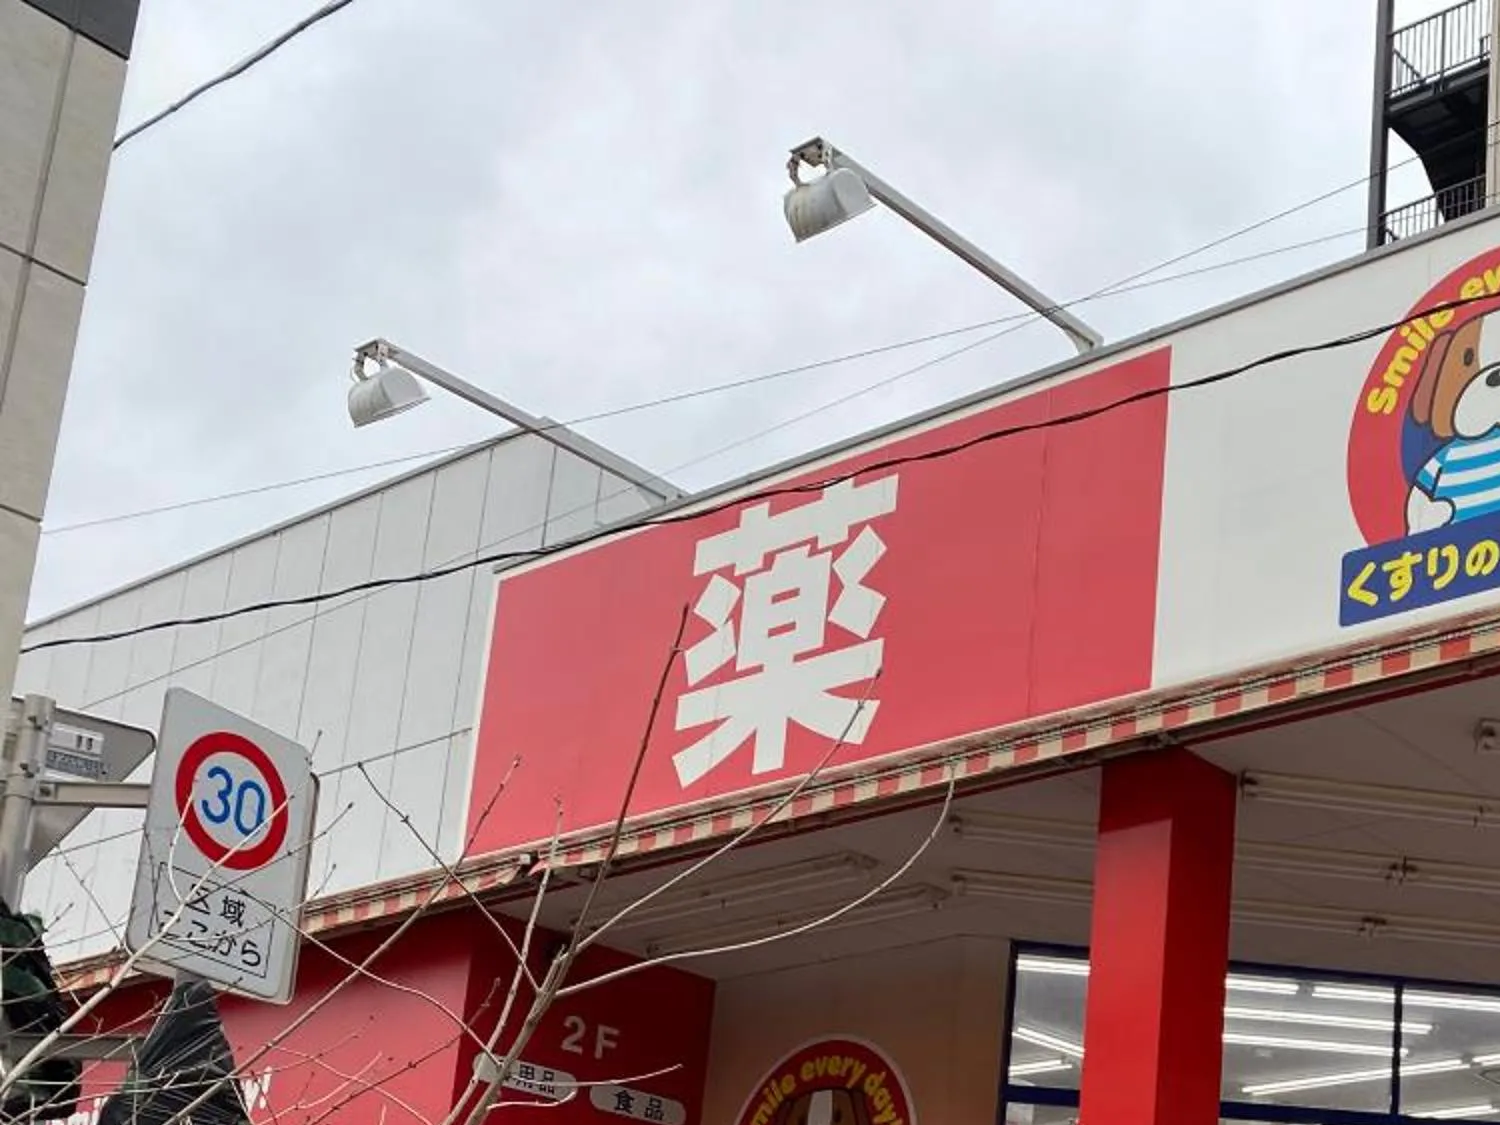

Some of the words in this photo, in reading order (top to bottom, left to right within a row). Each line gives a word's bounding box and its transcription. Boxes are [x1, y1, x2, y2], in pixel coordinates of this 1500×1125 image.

[1367, 302, 1455, 414] Smile
[672, 473, 898, 788] 薬
[201, 765, 266, 836] 30
[185, 882, 247, 928] 区域
[157, 910, 262, 967] ここから
[799, 1056, 867, 1088] every
[614, 1089, 666, 1122] 食品
